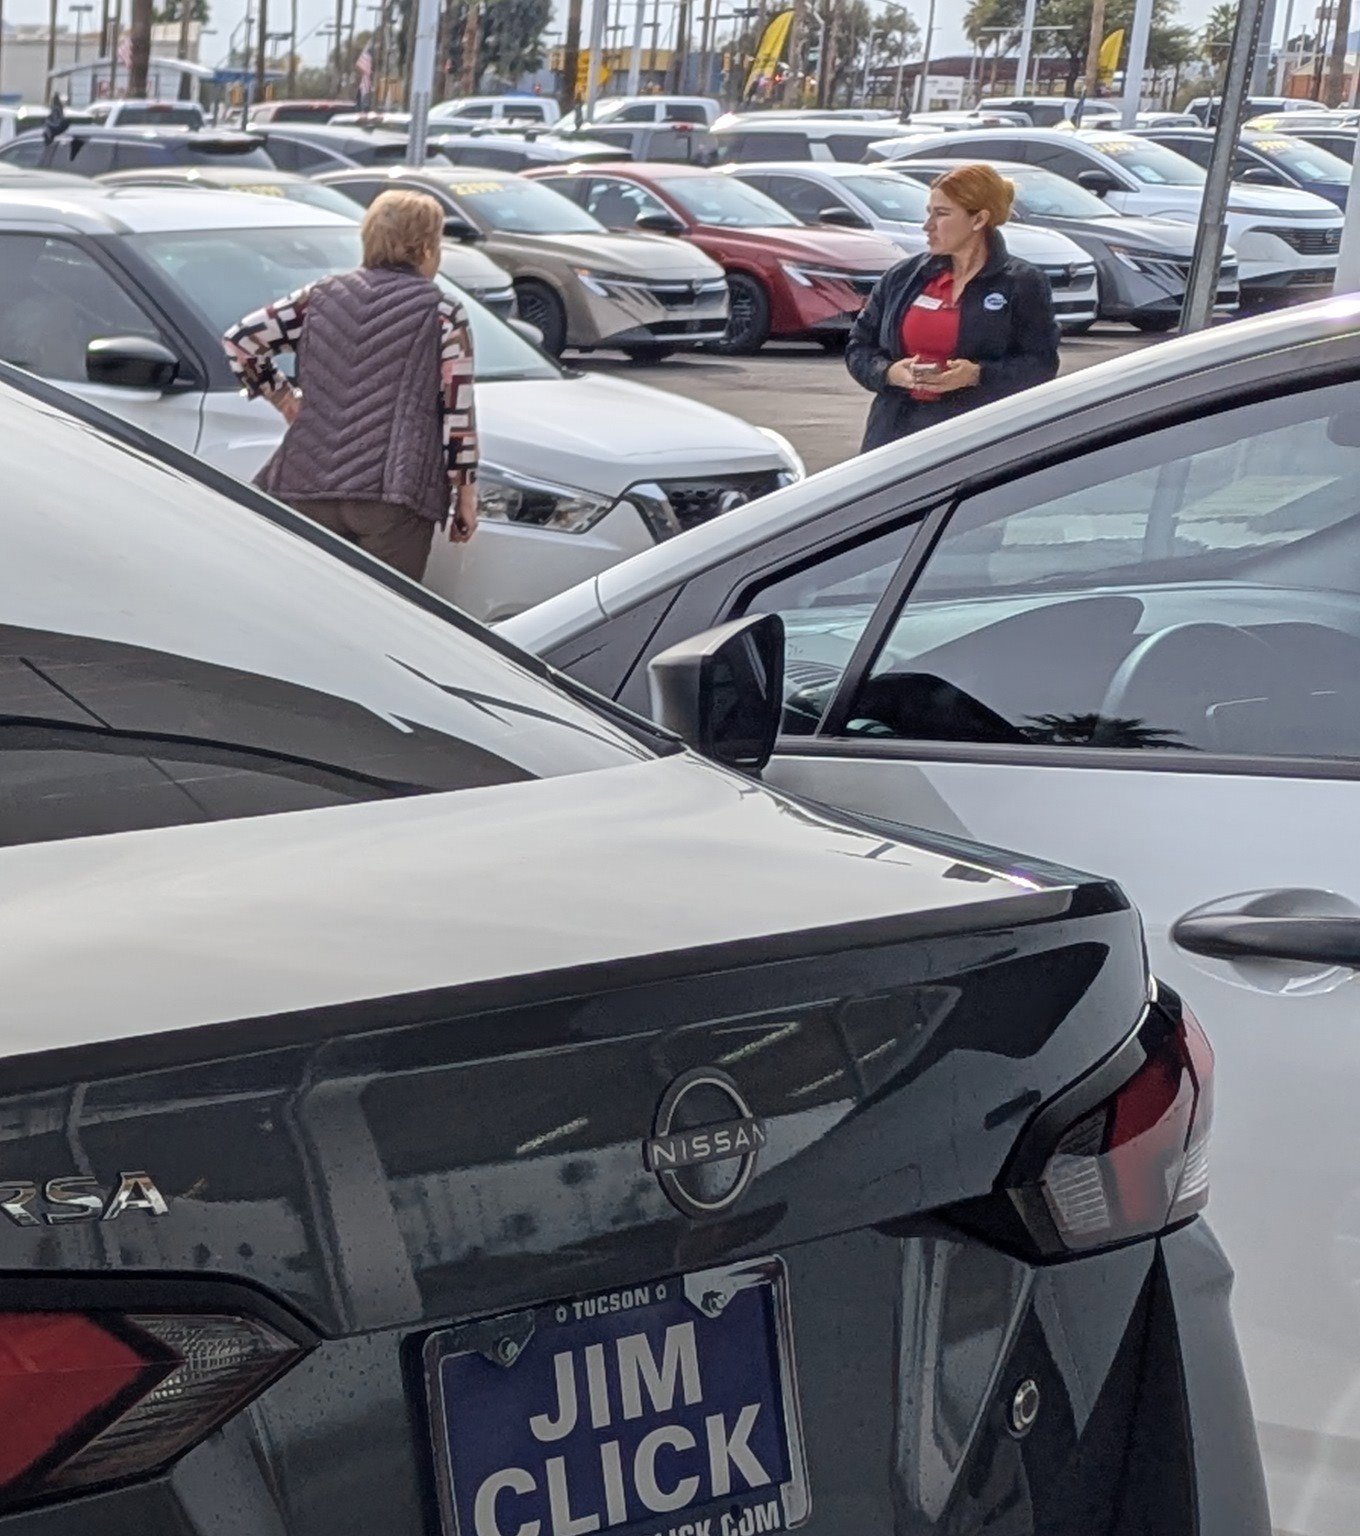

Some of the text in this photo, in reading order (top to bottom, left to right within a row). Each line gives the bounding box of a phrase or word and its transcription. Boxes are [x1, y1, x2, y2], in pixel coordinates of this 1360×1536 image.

[652, 1123, 765, 1166] NISSAN
[572, 1286, 650, 1320] TUCSON
[529, 1321, 703, 1442] JIM
